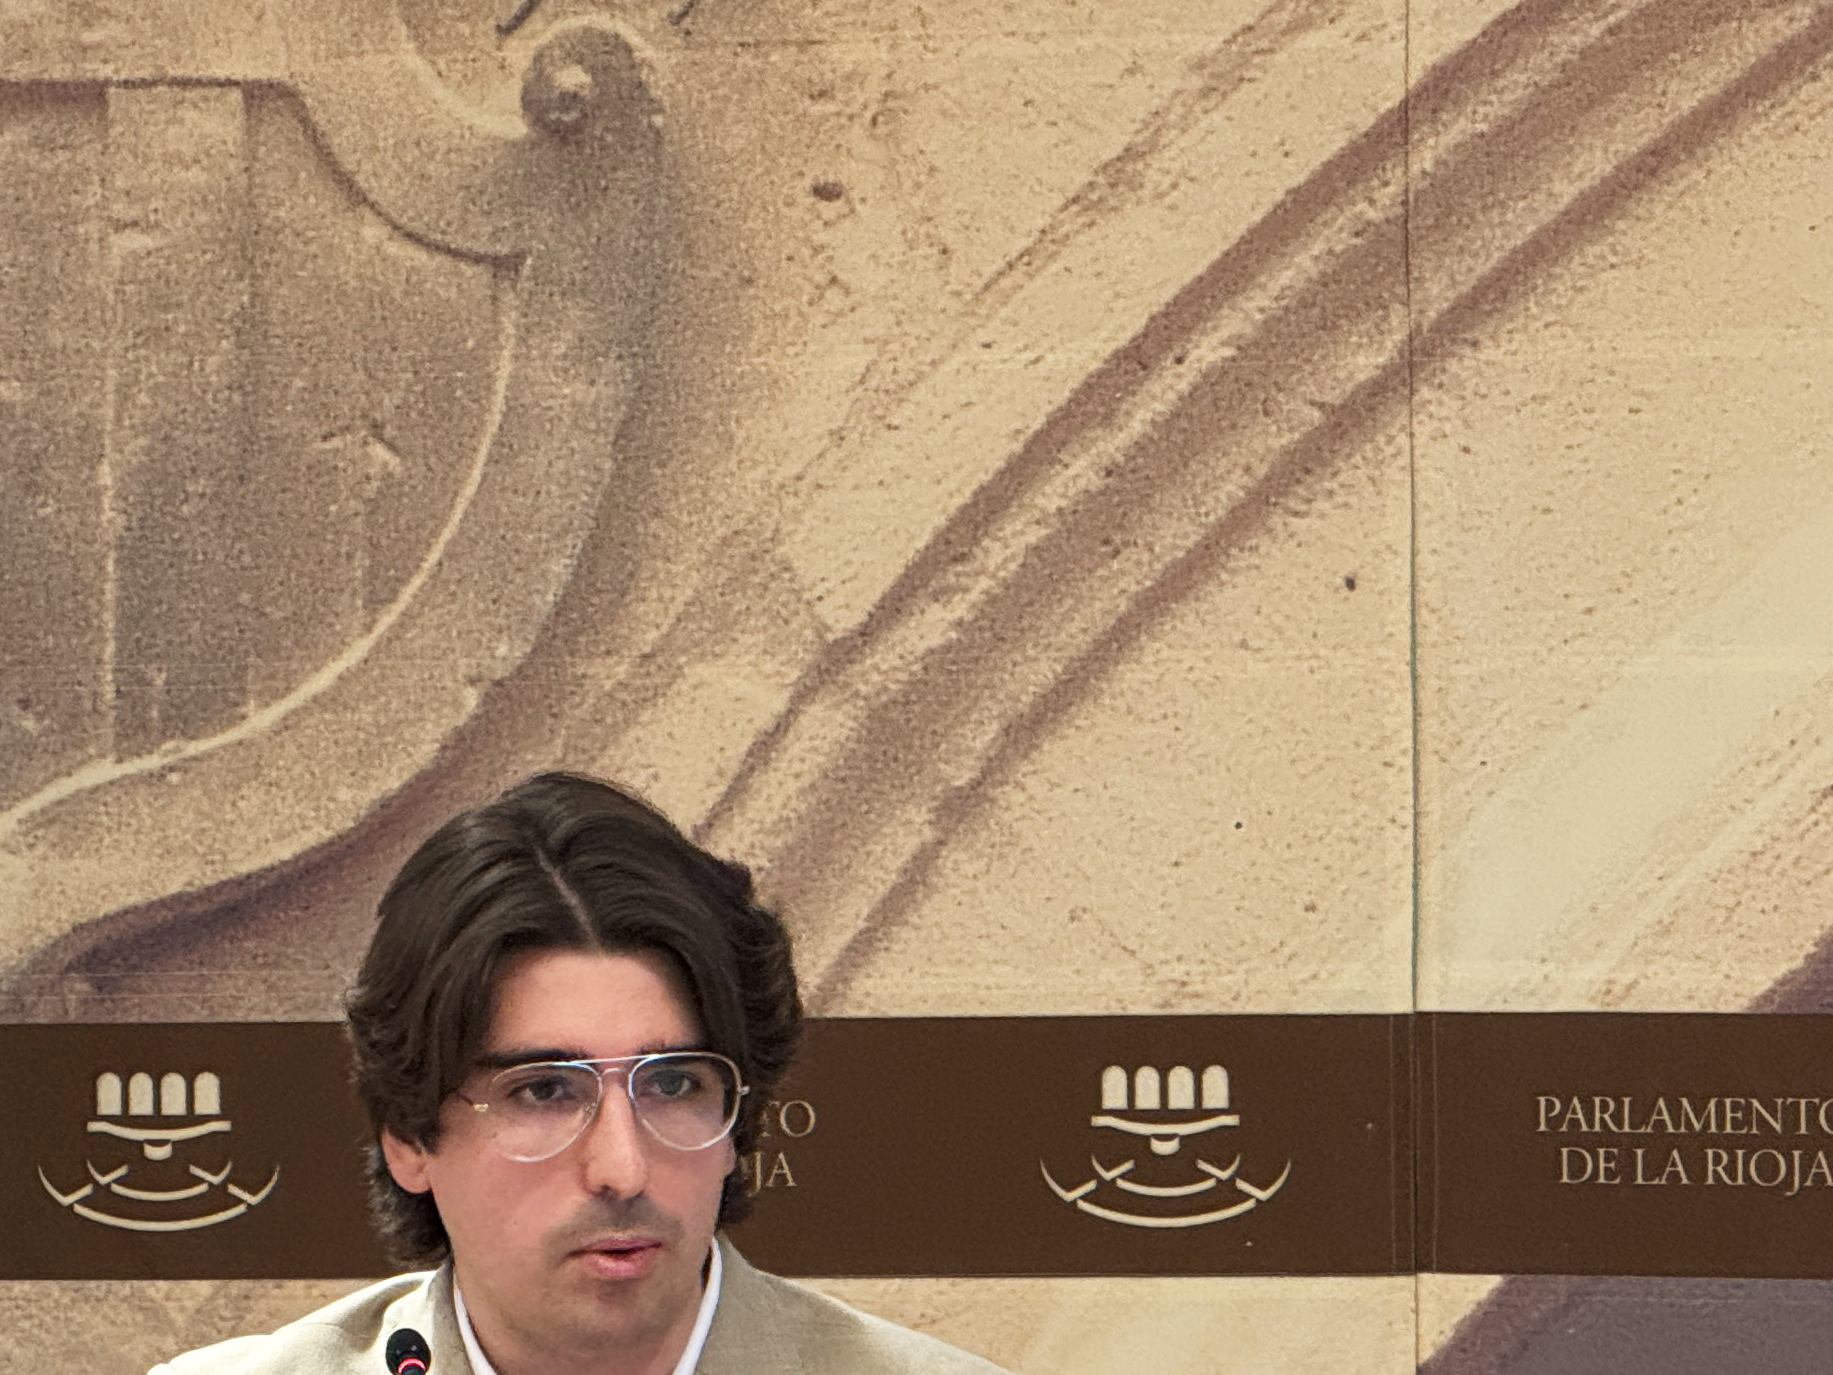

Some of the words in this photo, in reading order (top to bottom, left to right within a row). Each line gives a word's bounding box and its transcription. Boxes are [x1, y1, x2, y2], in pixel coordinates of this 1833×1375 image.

[1558, 1147, 1622, 1185] DE
[1633, 1148, 1693, 1186] LA
[1703, 1149, 1833, 1197] RIOJA
